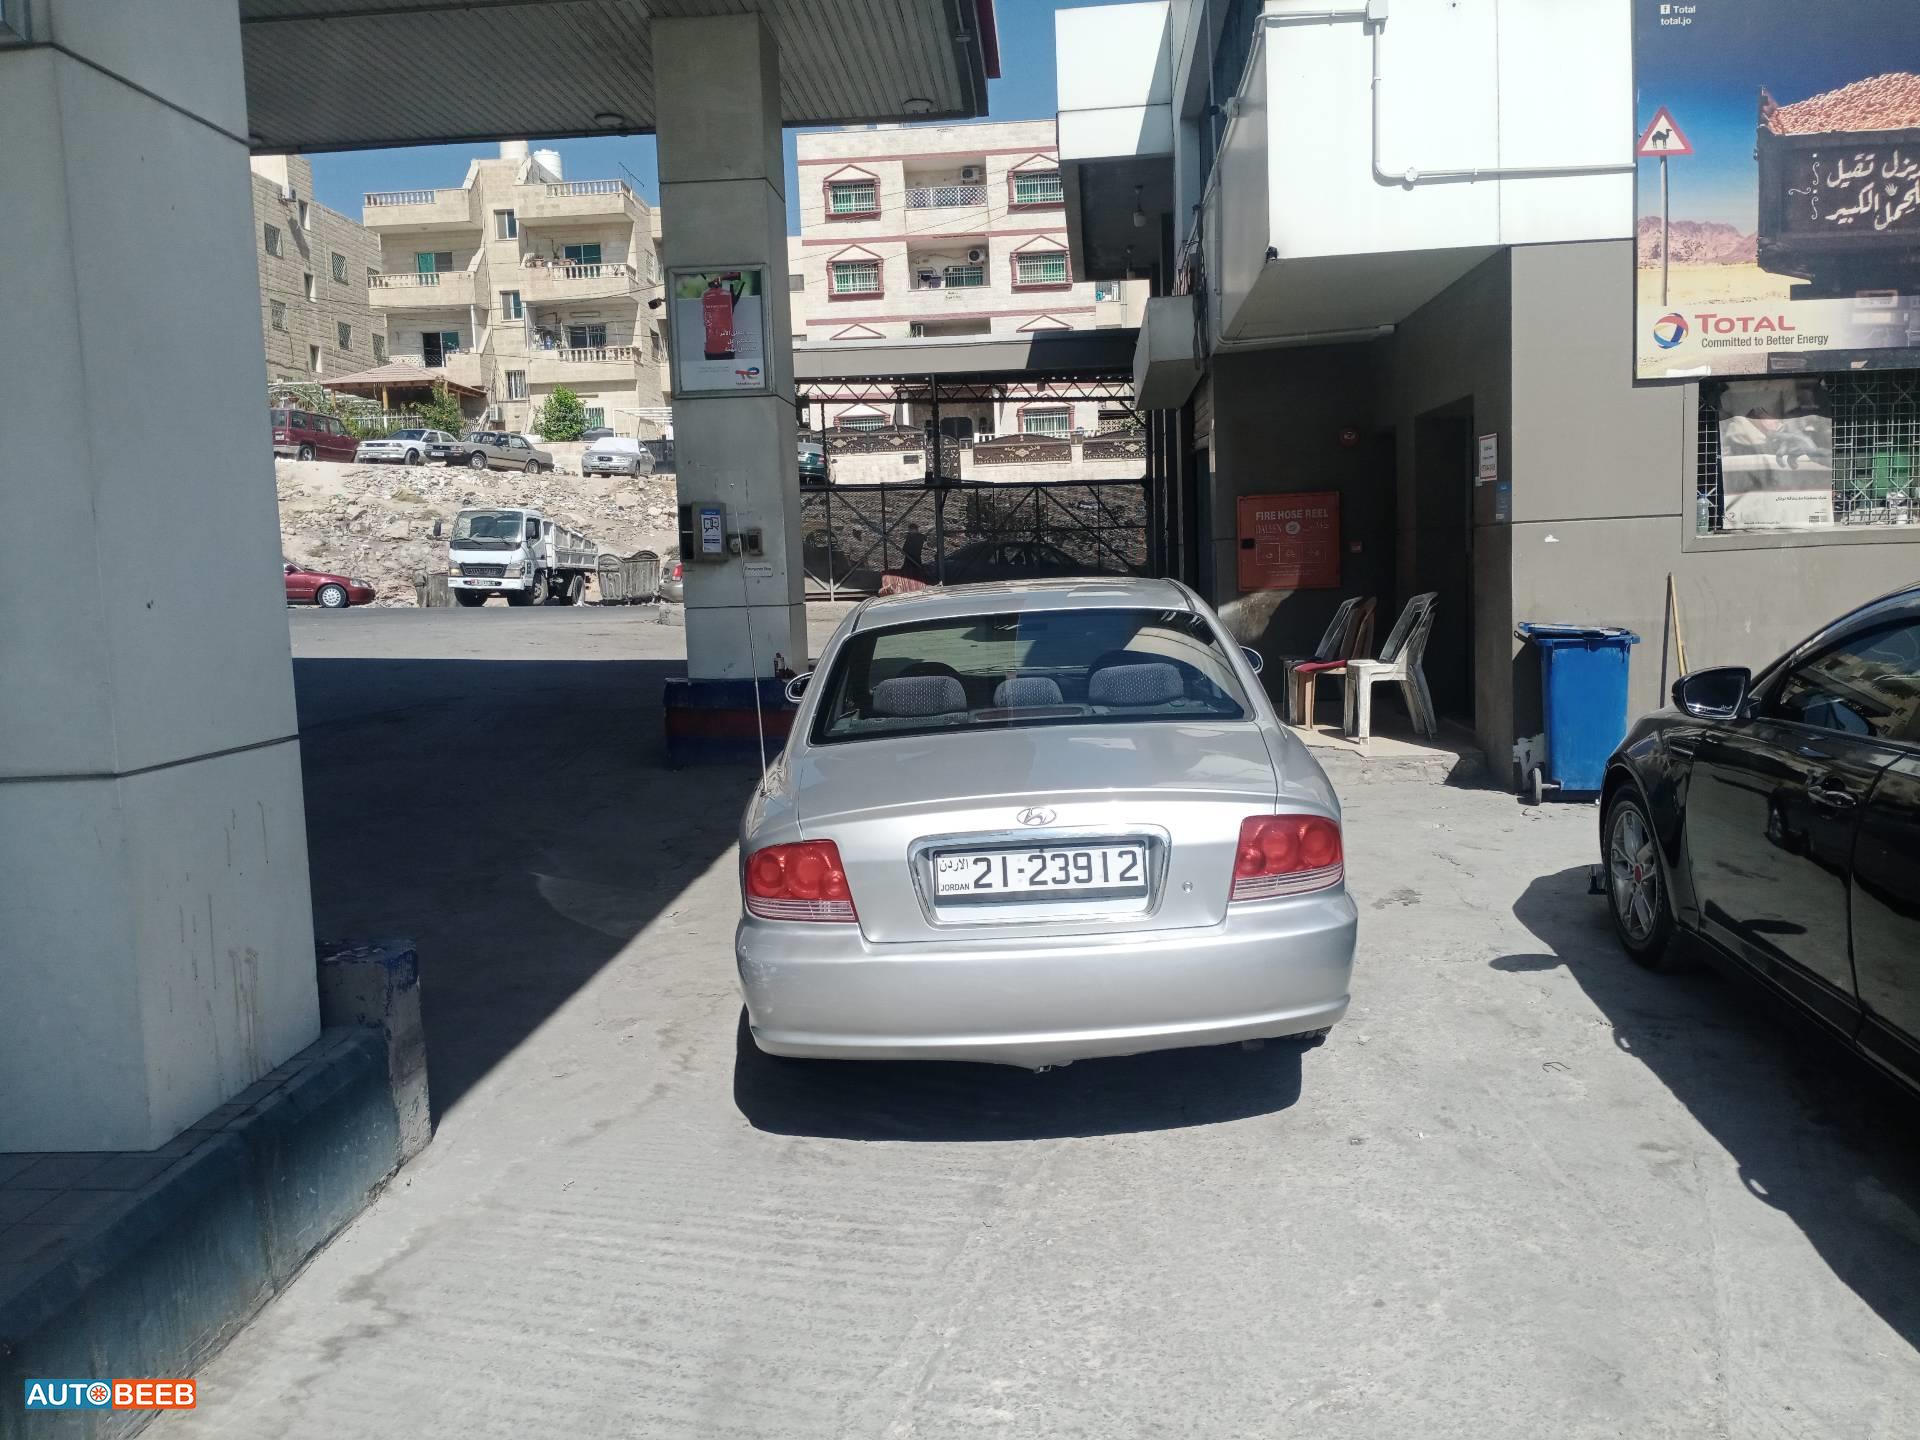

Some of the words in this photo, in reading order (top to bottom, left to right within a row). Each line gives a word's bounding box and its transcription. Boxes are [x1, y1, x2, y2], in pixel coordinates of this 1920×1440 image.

[1672, 4, 1696, 14] Total
[1660, 16, 1692, 26] total.jo
[1825, 182, 1879, 225] الكبير
[1694, 313, 1796, 335] TOTAL
[1701, 336, 1752, 348] Committed
[1755, 335, 1764, 346] to
[1766, 334, 1795, 346] Better
[1797, 333, 1829, 346] Energy
[1255, 511, 1277, 521] FIRE
[1278, 509, 1303, 520] HOSE
[1305, 508, 1329, 520] REEL
[972, 850, 1139, 889] 21-23912
[940, 882, 970, 892] JORDAN
